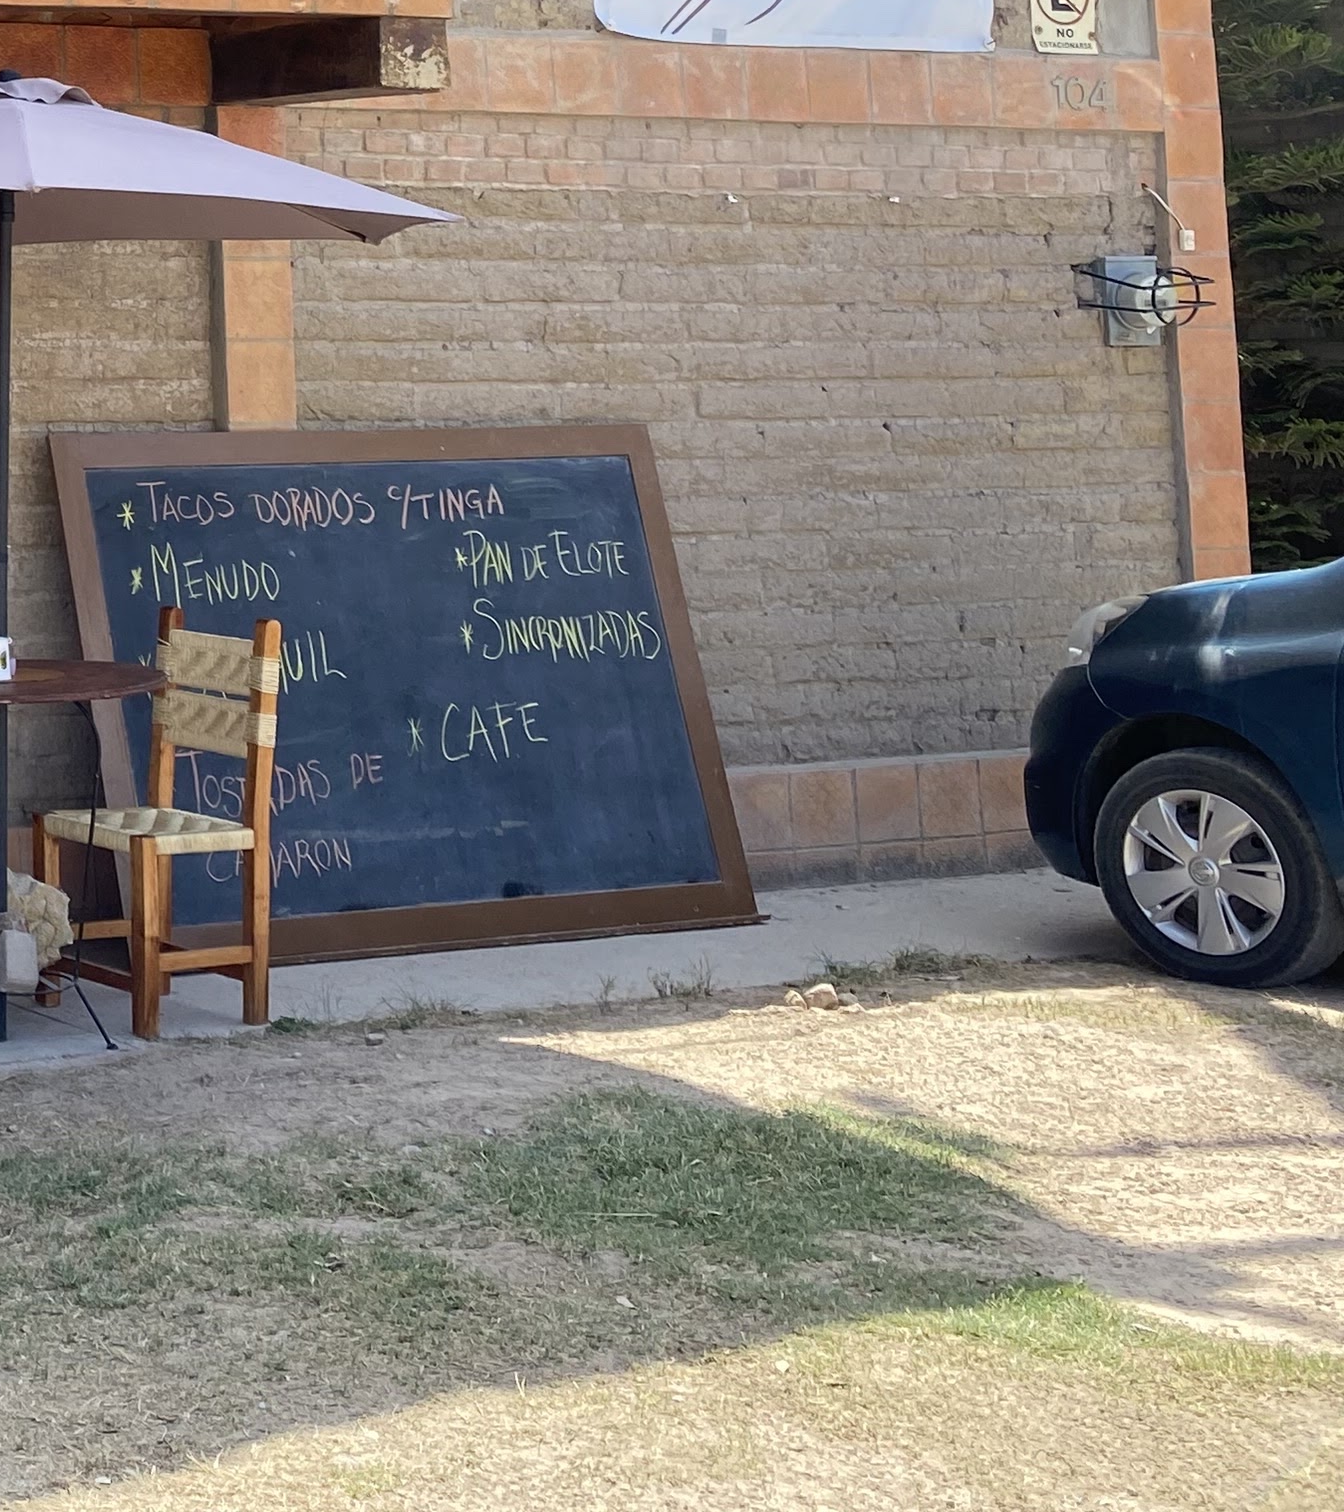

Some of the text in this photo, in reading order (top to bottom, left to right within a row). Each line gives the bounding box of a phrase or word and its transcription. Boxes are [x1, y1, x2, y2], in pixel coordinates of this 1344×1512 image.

[1039, 41, 1093, 50] ESTACIONARSE
[1056, 28, 1074, 38] NO
[1051, 75, 1107, 112] 104
[136, 481, 235, 525] TACOS
[248, 486, 376, 531] DORADOS
[150, 542, 281, 609] MENUDO
[463, 530, 630, 588] PAN DE ELOTE
[473, 598, 661, 663] SINCRONIZADAS
[441, 702, 548, 763] CAFE
[175, 750, 384, 817] TOSTDAS DE
